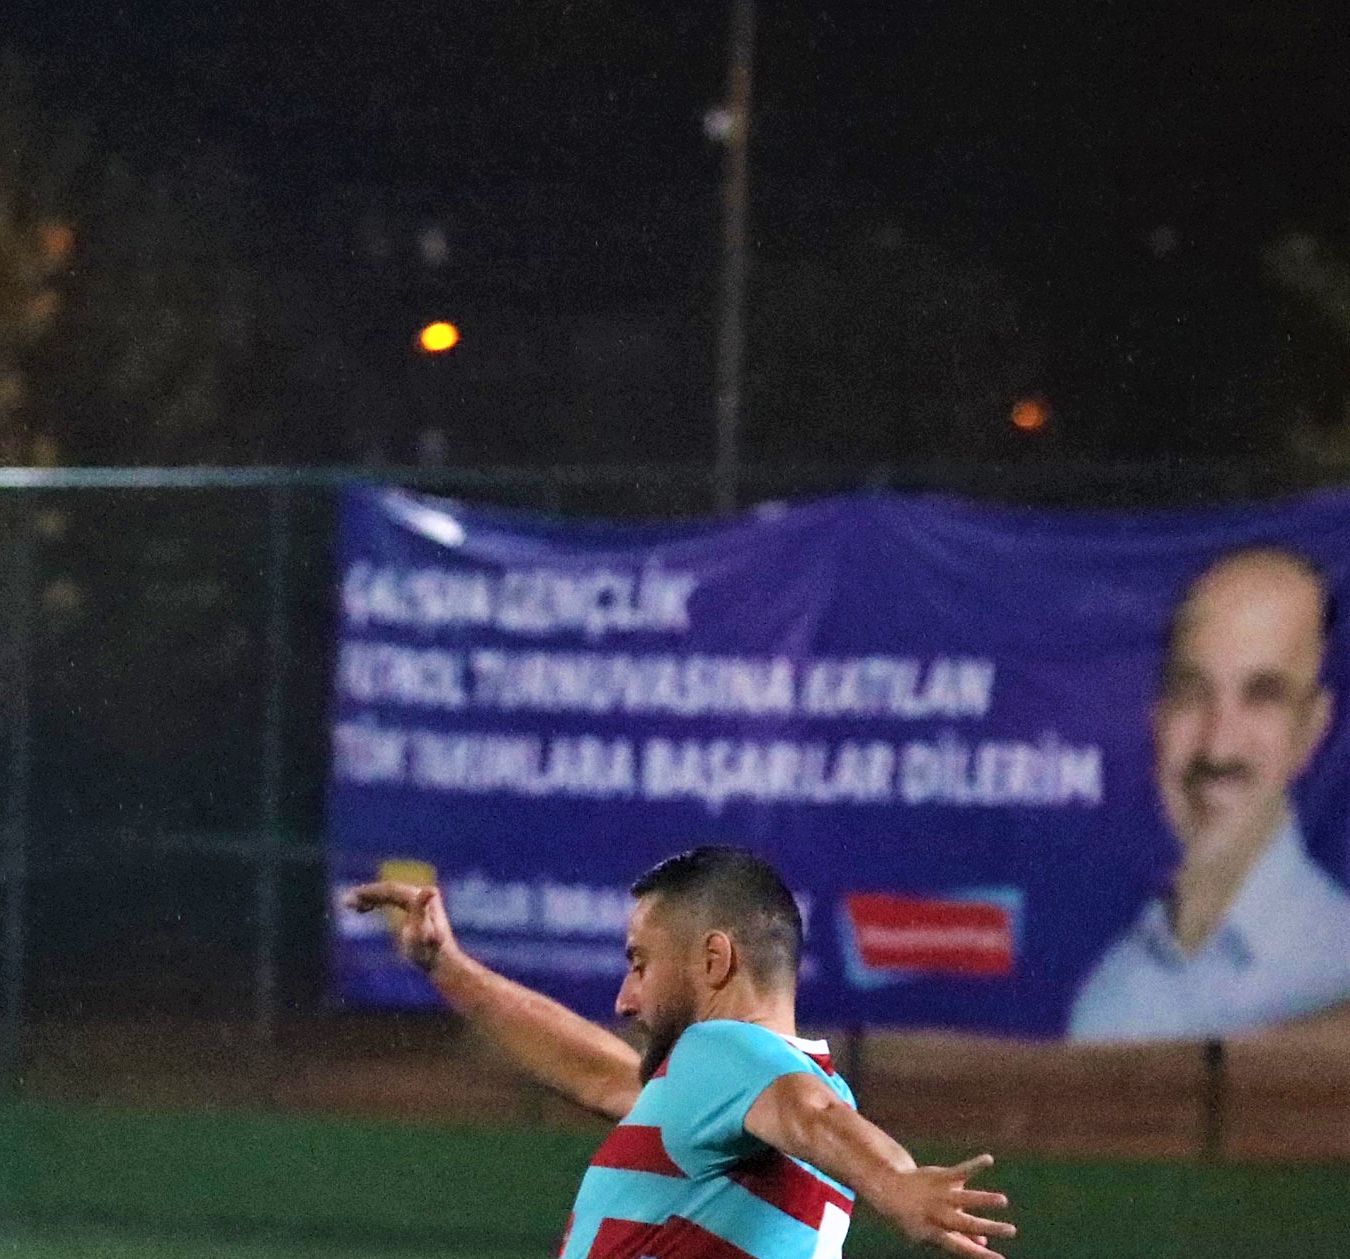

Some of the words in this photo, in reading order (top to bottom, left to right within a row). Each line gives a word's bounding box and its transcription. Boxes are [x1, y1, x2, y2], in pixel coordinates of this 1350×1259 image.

[802, 655, 997, 718] KATILAN
[645, 740, 892, 813] BAŞARILAR
[900, 732, 1103, 805] DİLERİM
